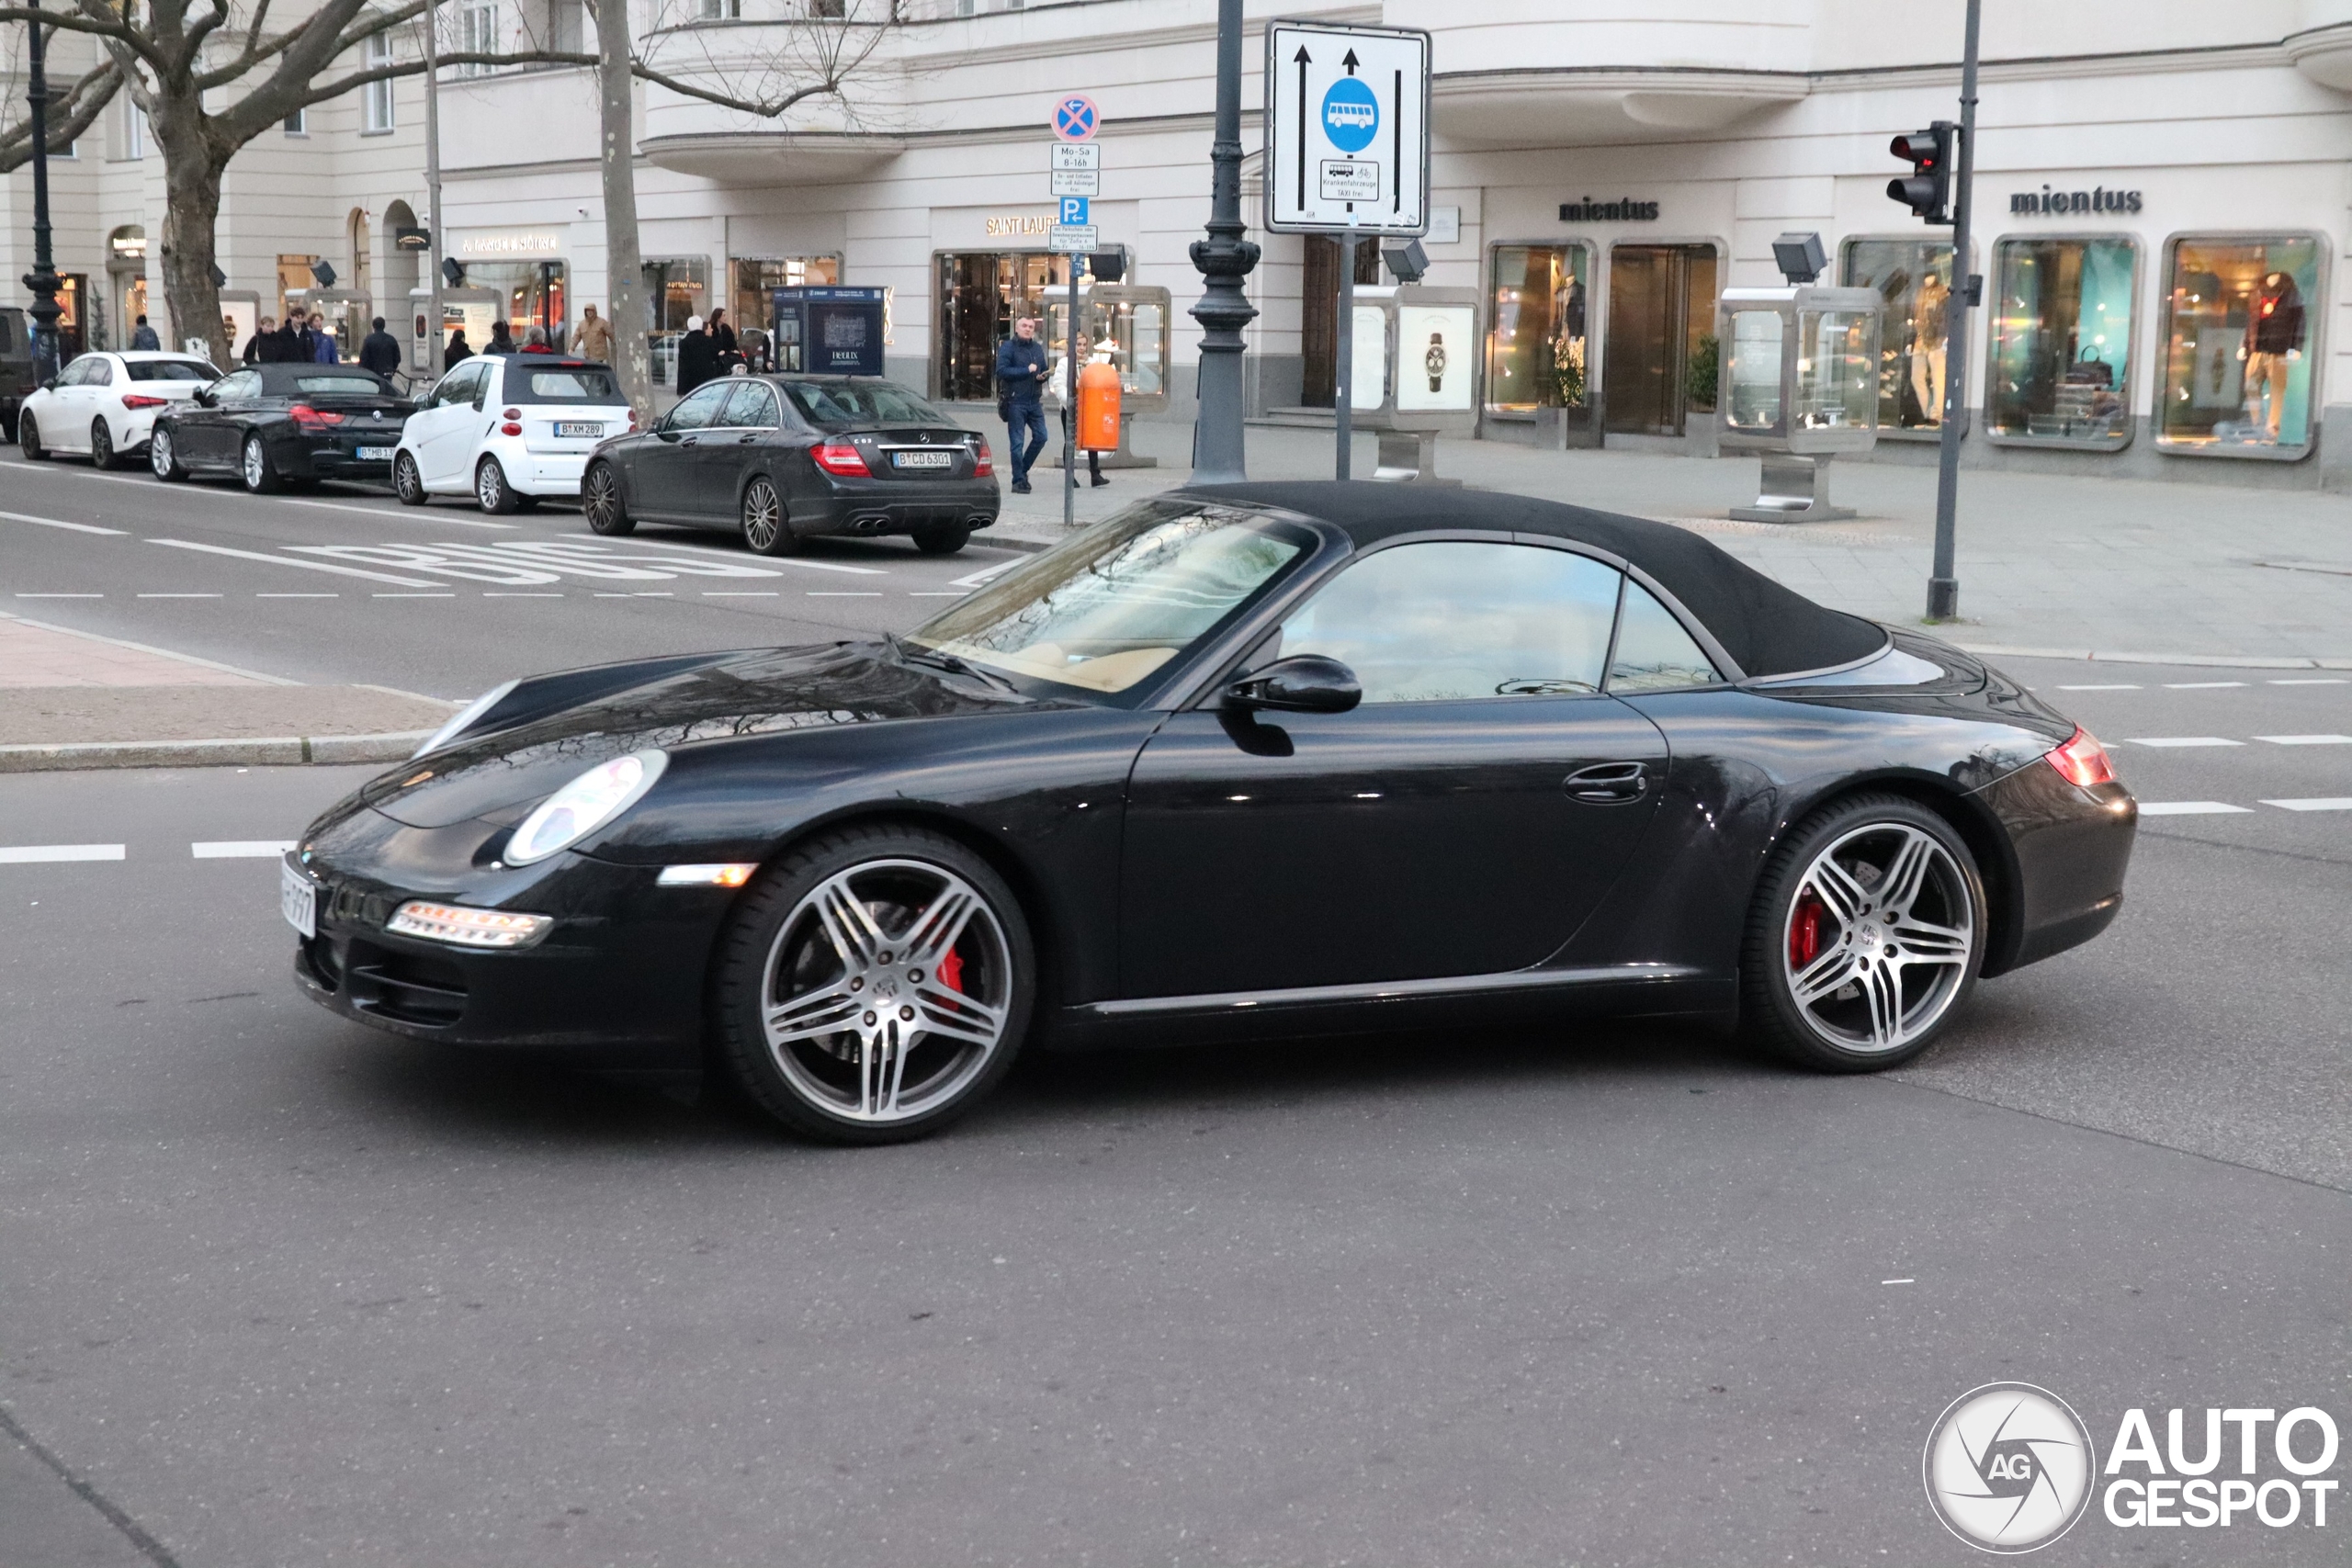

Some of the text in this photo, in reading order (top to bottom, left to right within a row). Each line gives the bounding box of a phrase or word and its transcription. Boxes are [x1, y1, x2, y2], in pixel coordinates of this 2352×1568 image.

[1061, 147, 1090, 155] Mo-Sa
[1064, 158, 1087, 166] 8-16h
[1323, 179, 1376, 188] Krankenfahrzeuge
[2009, 184, 2143, 213] mientus
[1064, 199, 1080, 222] P
[1559, 196, 1658, 221] mientus
[987, 218, 1020, 234] SAINT
[562, 424, 600, 434] B XM 289
[362, 448, 368, 457] B
[899, 454, 950, 465] B CD 6301
[277, 541, 784, 586] BUS
